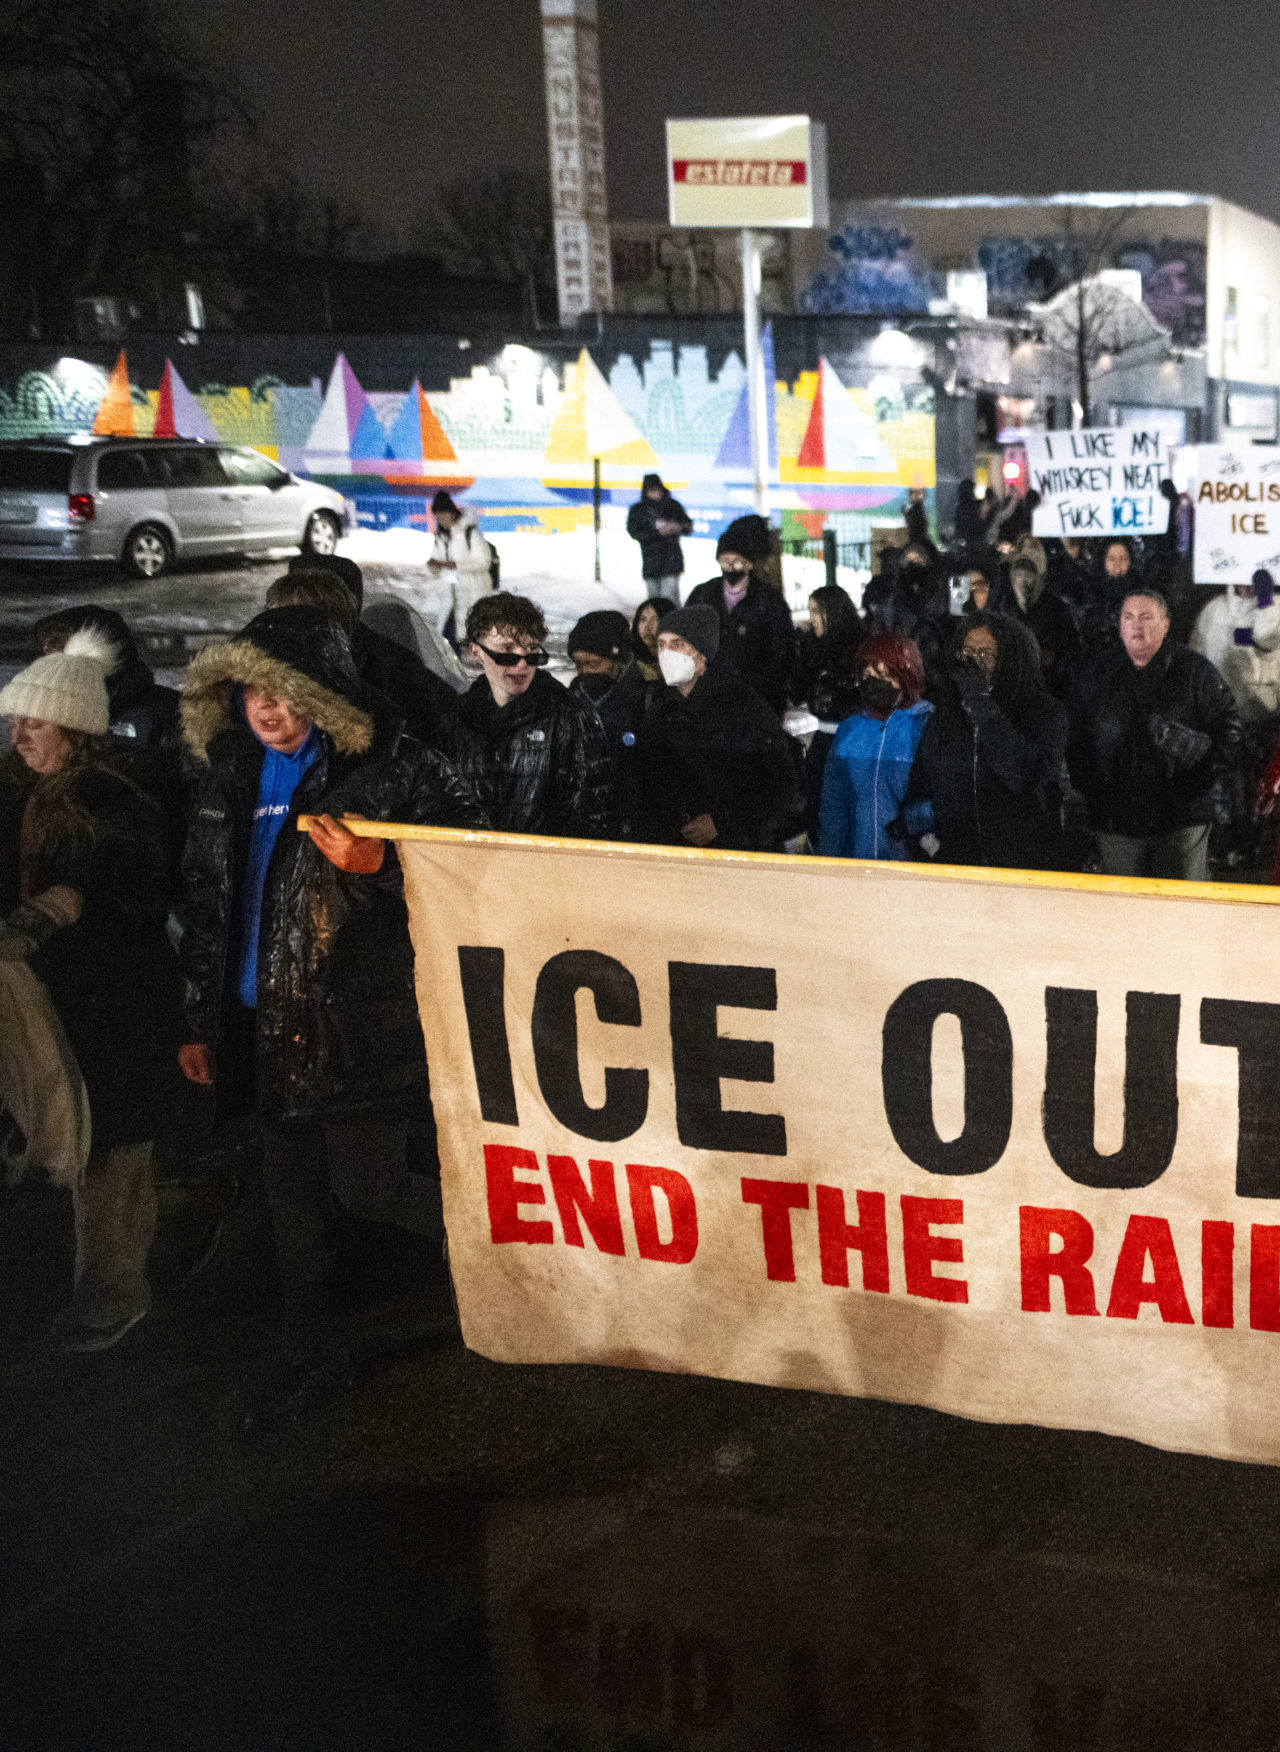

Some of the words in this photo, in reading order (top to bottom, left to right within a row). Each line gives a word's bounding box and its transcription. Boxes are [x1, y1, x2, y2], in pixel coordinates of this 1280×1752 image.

[1045, 436, 1054, 460] I
[1070, 433, 1116, 459] LIKE
[1131, 431, 1160, 458] MY
[1123, 462, 1165, 490] NEAT
[1230, 513, 1270, 535] ICE
[457, 945, 788, 1157] ICE
[482, 1143, 699, 1264] END
[740, 1178, 969, 1304] THE
